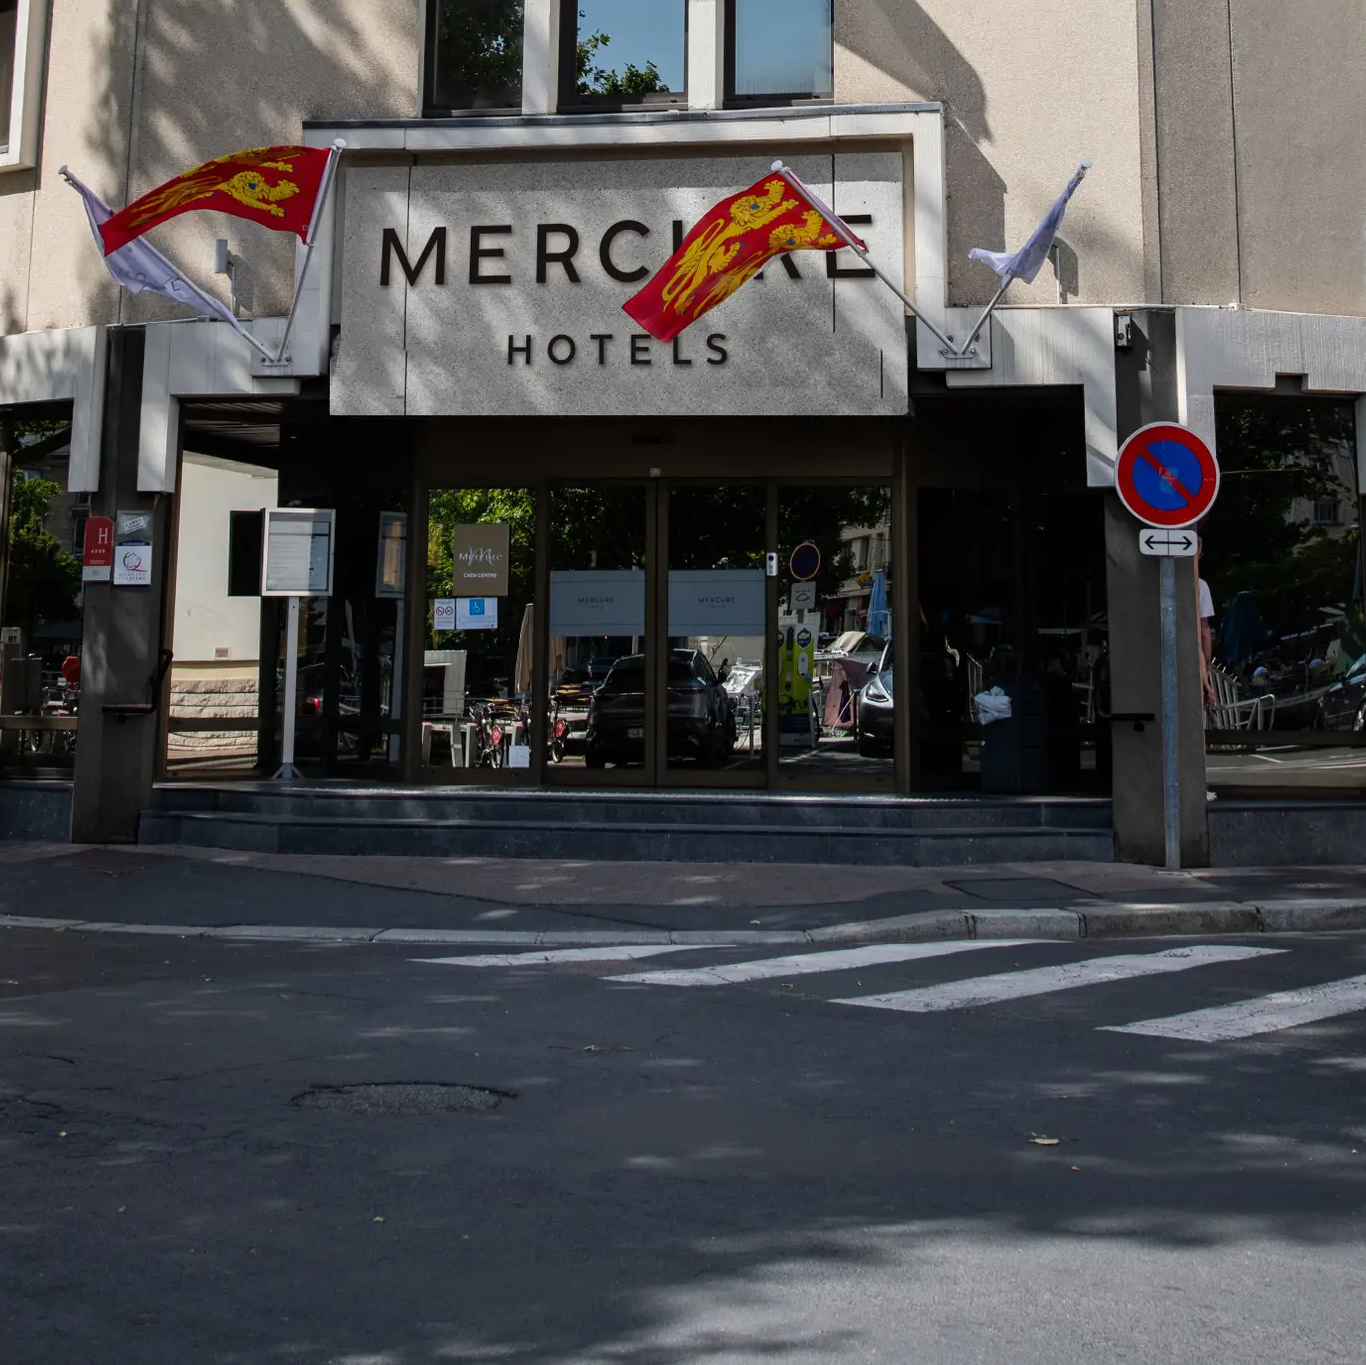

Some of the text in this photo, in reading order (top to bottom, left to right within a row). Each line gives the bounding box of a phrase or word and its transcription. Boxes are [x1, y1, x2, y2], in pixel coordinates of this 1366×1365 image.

[380, 214, 876, 286] MERCE
[507, 334, 729, 365] HOTELS
[98, 527, 108, 544] H
